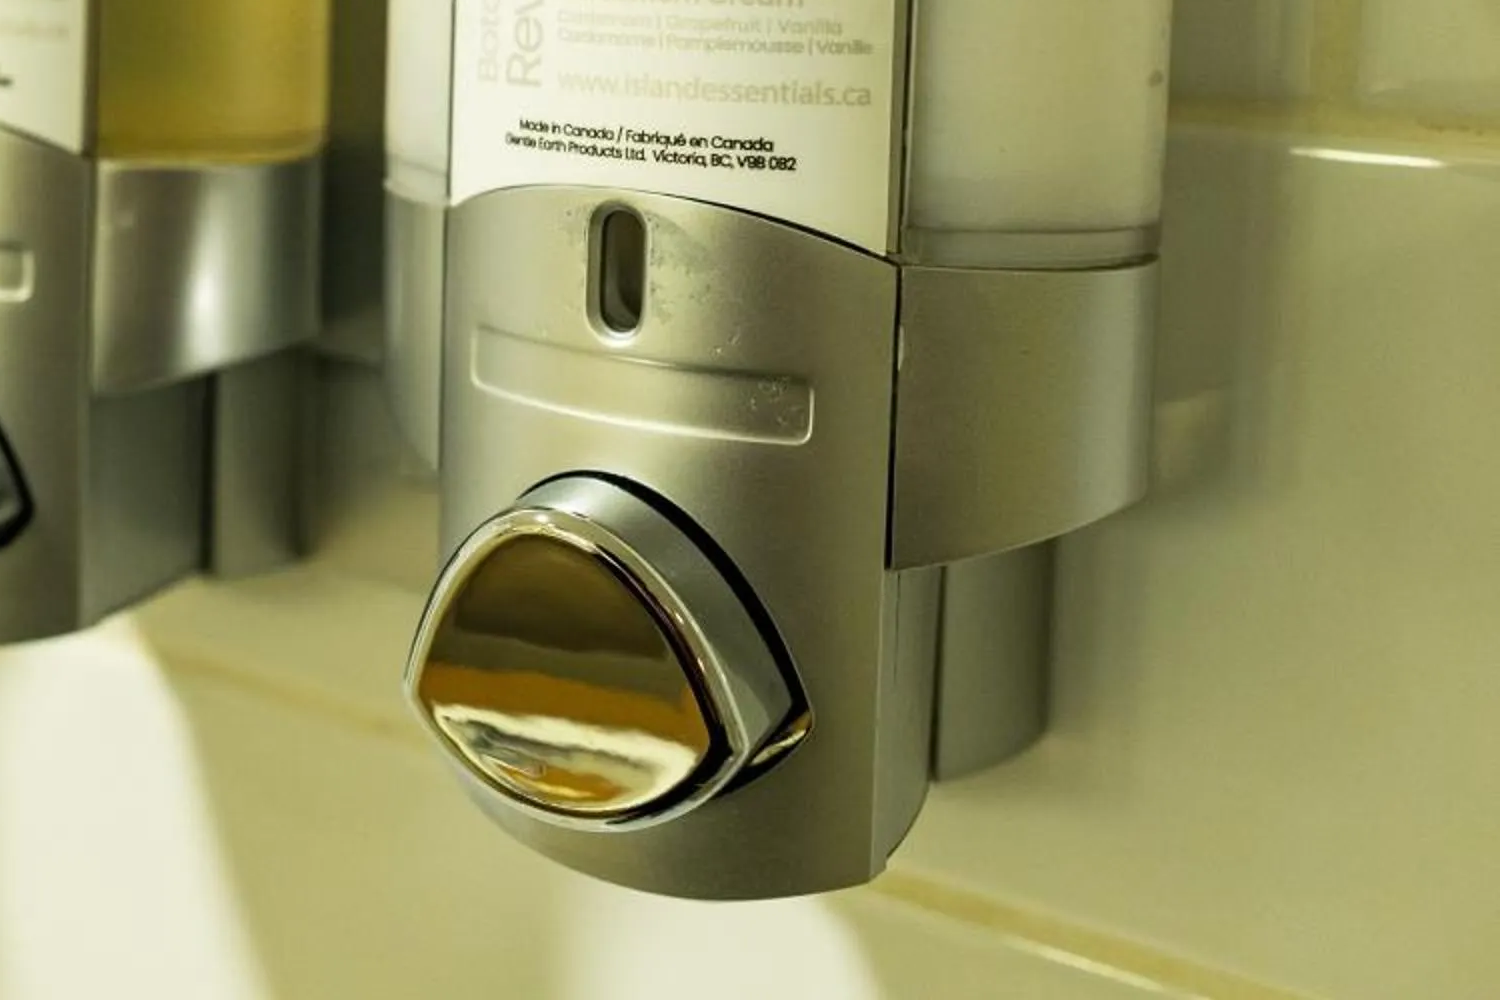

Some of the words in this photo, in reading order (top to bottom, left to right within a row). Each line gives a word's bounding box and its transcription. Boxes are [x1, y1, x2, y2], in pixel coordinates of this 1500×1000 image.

[778, 17, 844, 36] Vanilla
[519, 118, 549, 133] Made
[551, 121, 561, 134] in
[563, 123, 614, 141] Canada
[626, 129, 687, 150] Fabriqué
[689, 136, 708, 149] en
[711, 135, 774, 152] Canada
[568, 141, 622, 160] Products
[652, 149, 707, 169] Victoria,
